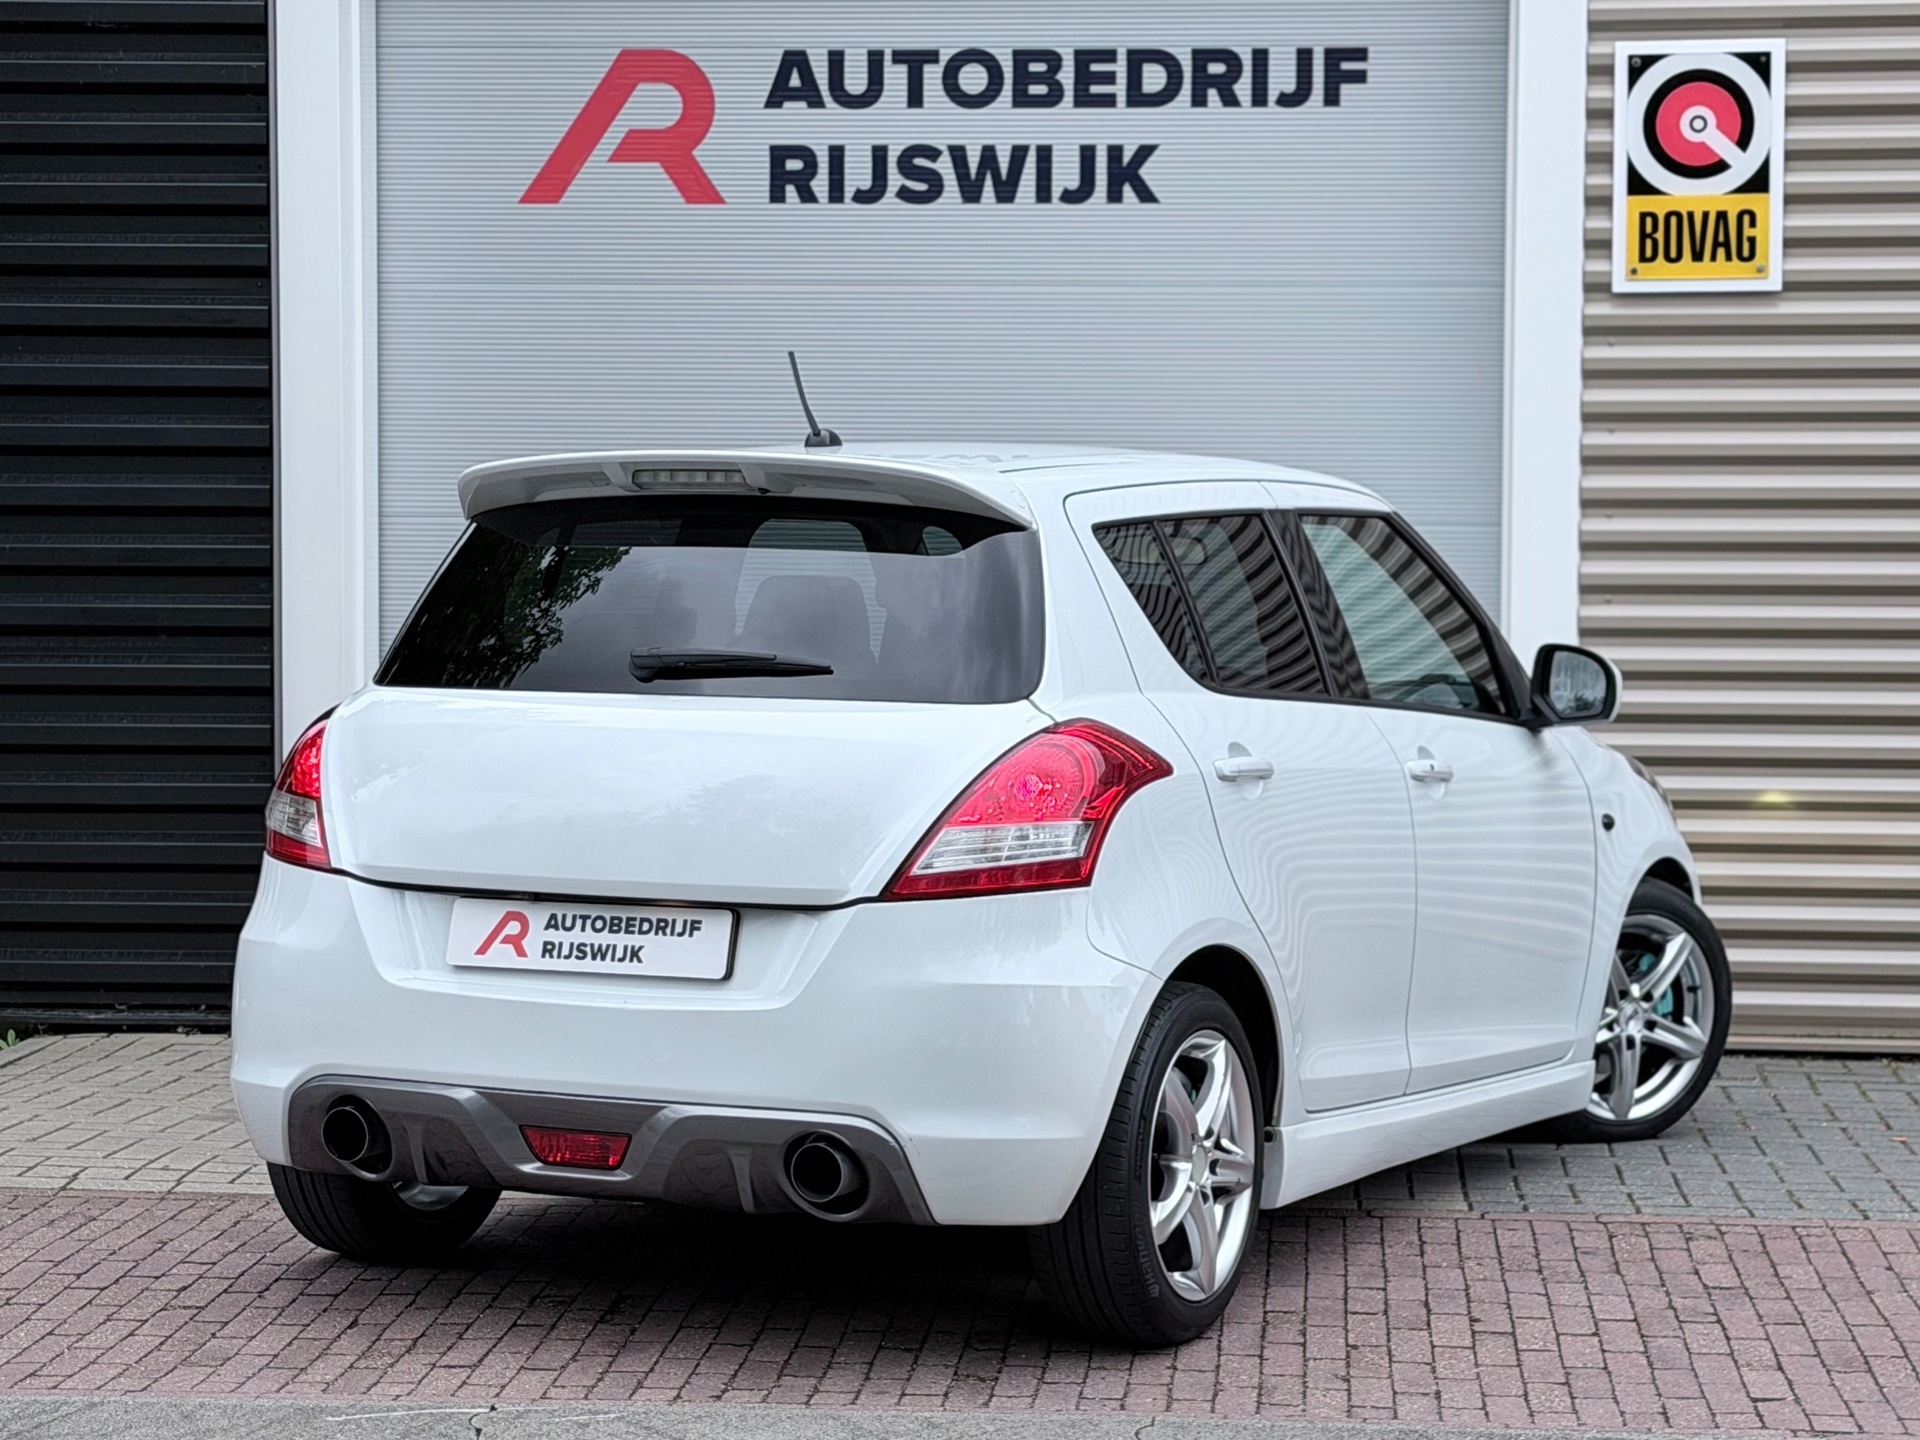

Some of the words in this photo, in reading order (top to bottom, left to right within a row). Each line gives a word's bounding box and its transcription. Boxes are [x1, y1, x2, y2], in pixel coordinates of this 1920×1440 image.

[764, 46, 1369, 109] AUTOBEDRIJF
[768, 143, 1161, 205] RIJSWIJK
[1638, 208, 1758, 264] BOVAG
[541, 940, 646, 964] RIJSWIJK
[543, 912, 703, 938] AUTOBEDRIJF
